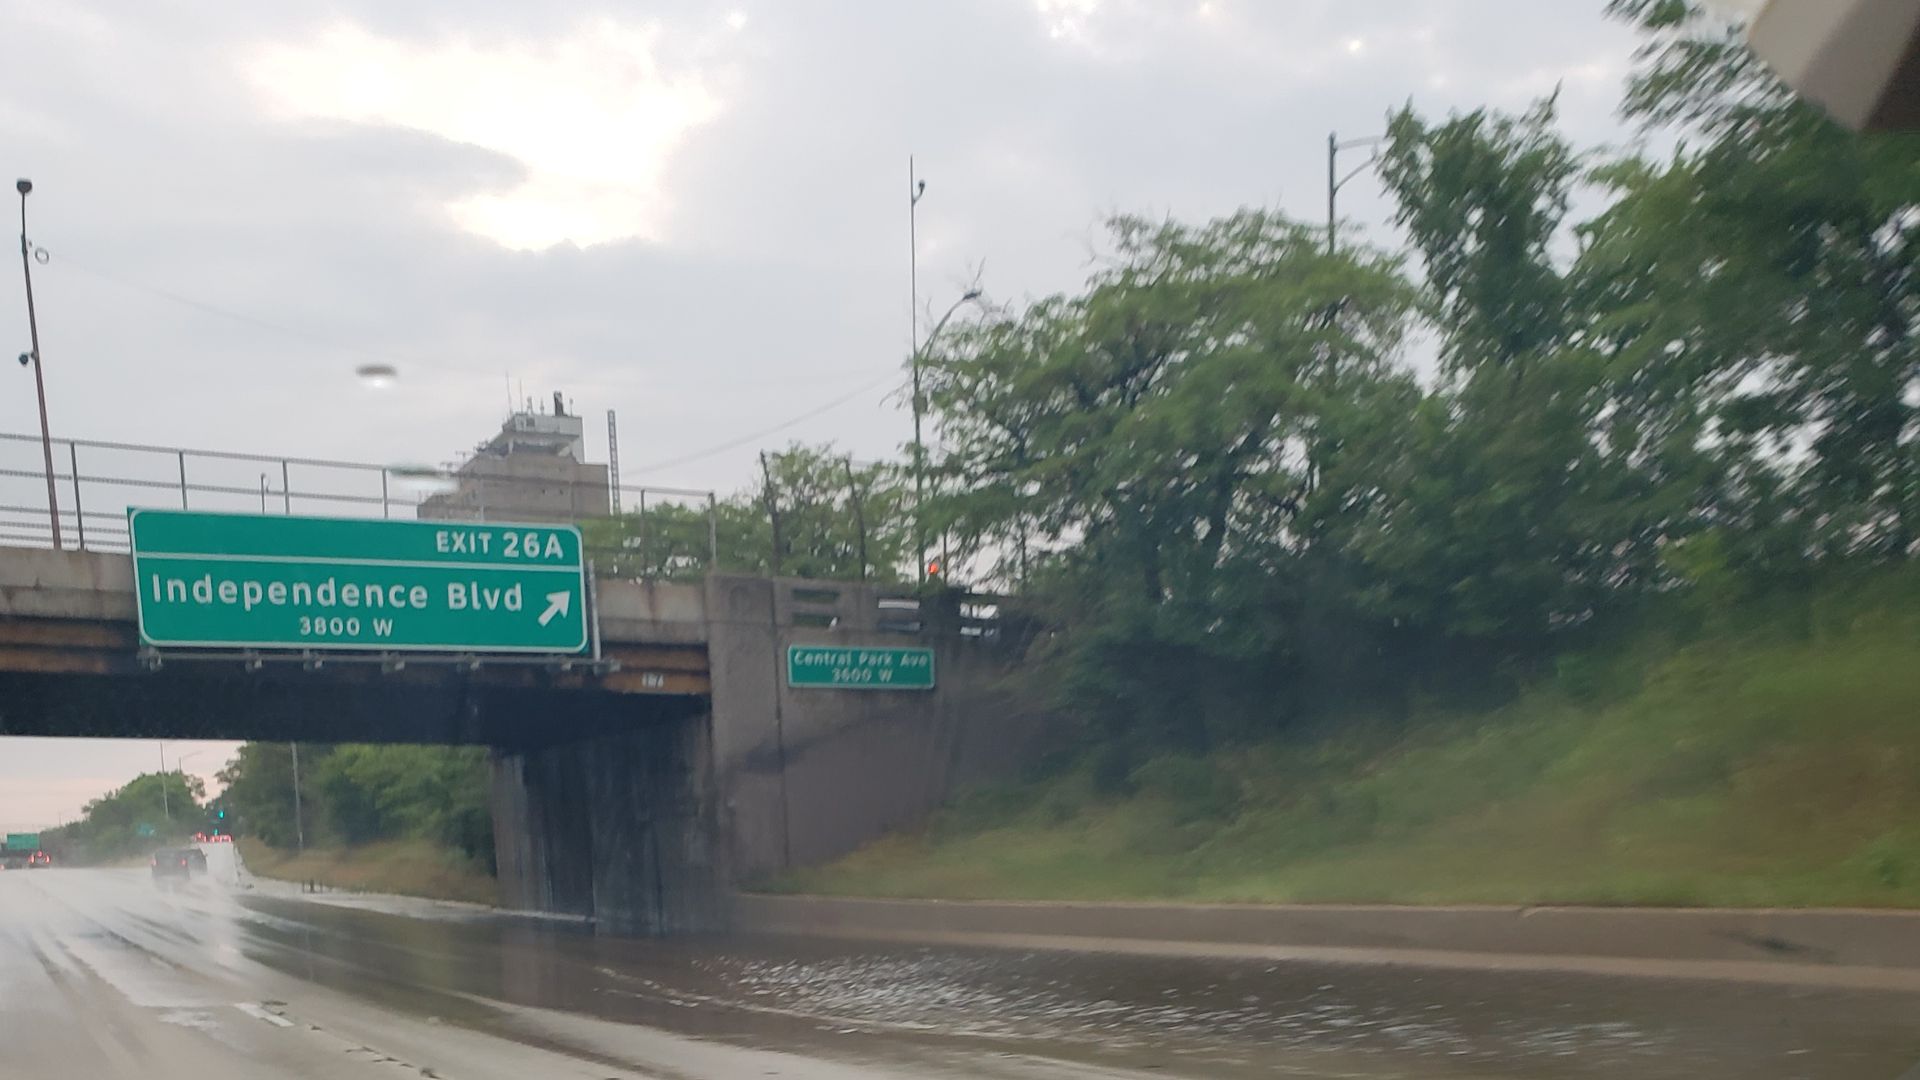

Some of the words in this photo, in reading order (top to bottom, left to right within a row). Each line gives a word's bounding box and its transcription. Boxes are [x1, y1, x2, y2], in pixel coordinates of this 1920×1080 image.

[436, 531, 492, 554] EXIT
[503, 532, 564, 559] 26A
[152, 573, 429, 611] Independence
[448, 582, 523, 611] Blvd
[299, 616, 361, 636] 3800
[373, 618, 393, 637] W
[794, 650, 852, 666] Central
[859, 651, 893, 665] Park
[900, 653, 928, 667] Ave
[878, 669, 894, 682] W
